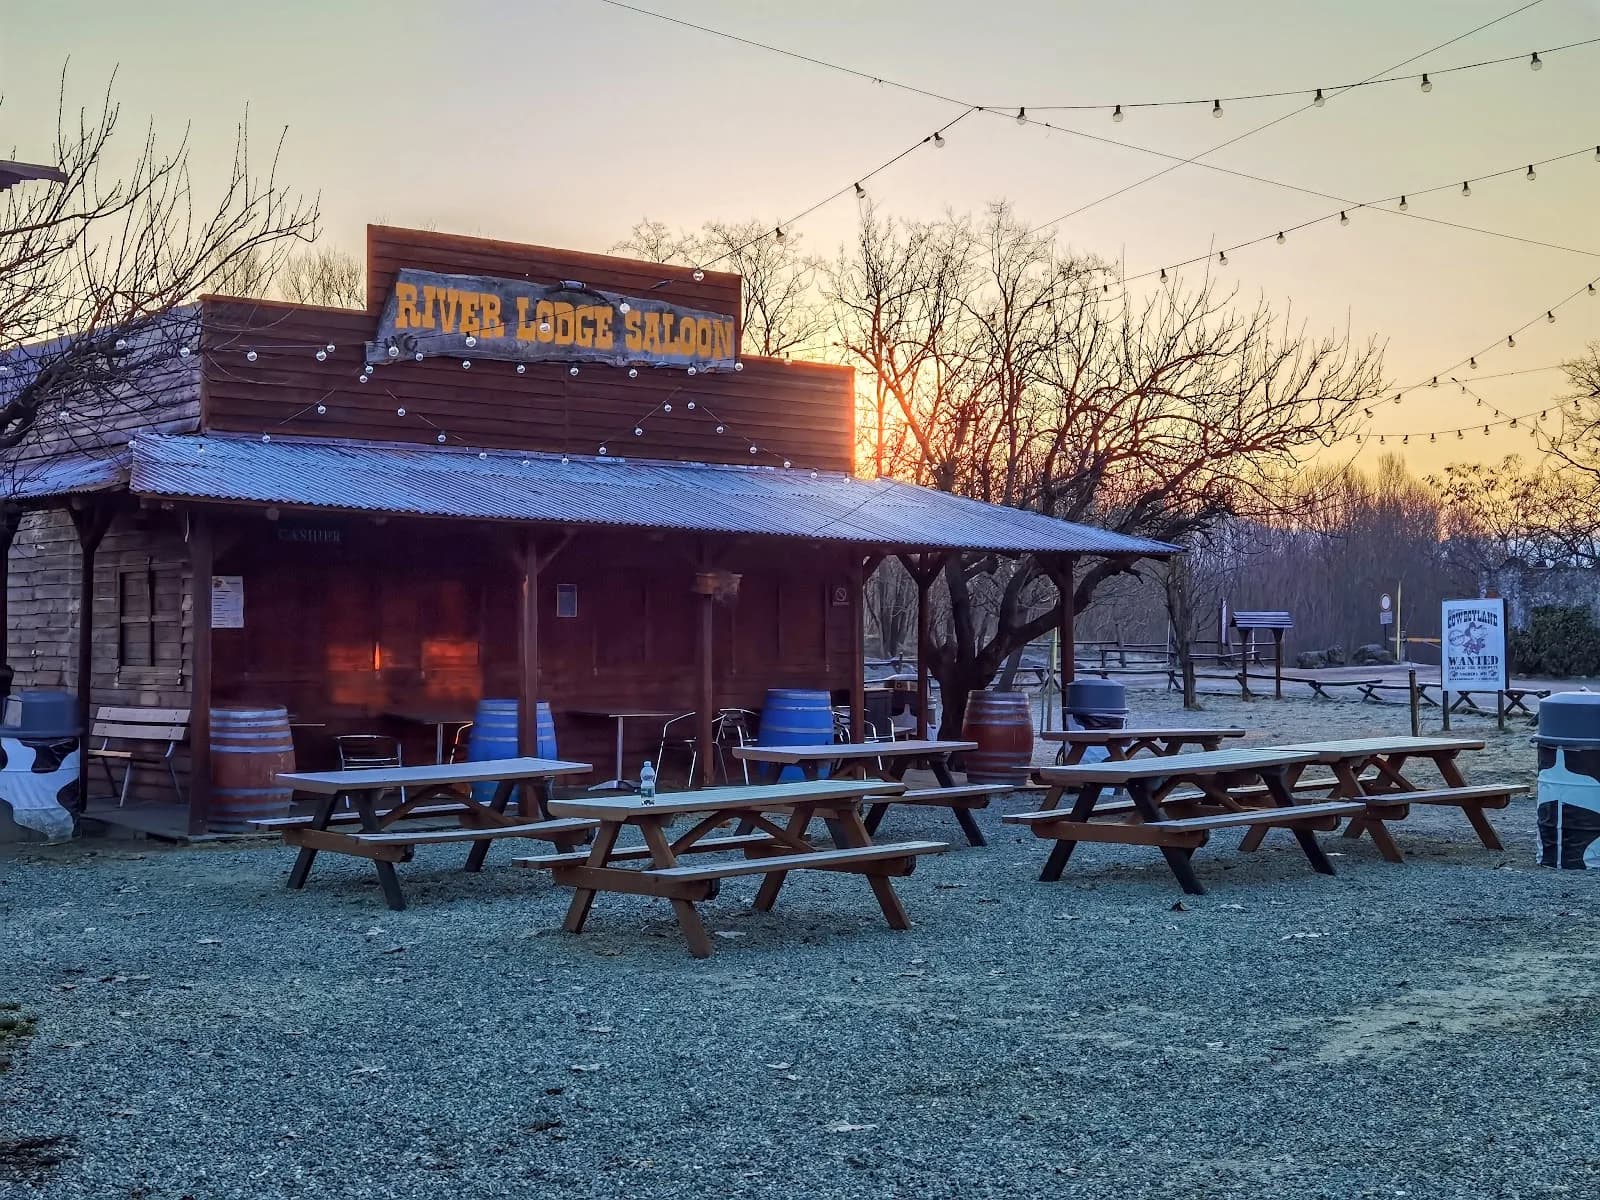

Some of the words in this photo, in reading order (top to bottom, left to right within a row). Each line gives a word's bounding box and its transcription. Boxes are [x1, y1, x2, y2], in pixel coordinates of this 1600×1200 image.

[395, 282, 504, 339] RIVER
[515, 297, 614, 349] LODGE
[623, 310, 733, 358] SALOON
[278, 528, 342, 543] CASHIER
[1448, 609, 1498, 628] COWBOYLAND
[1448, 656, 1499, 665] WANTED
